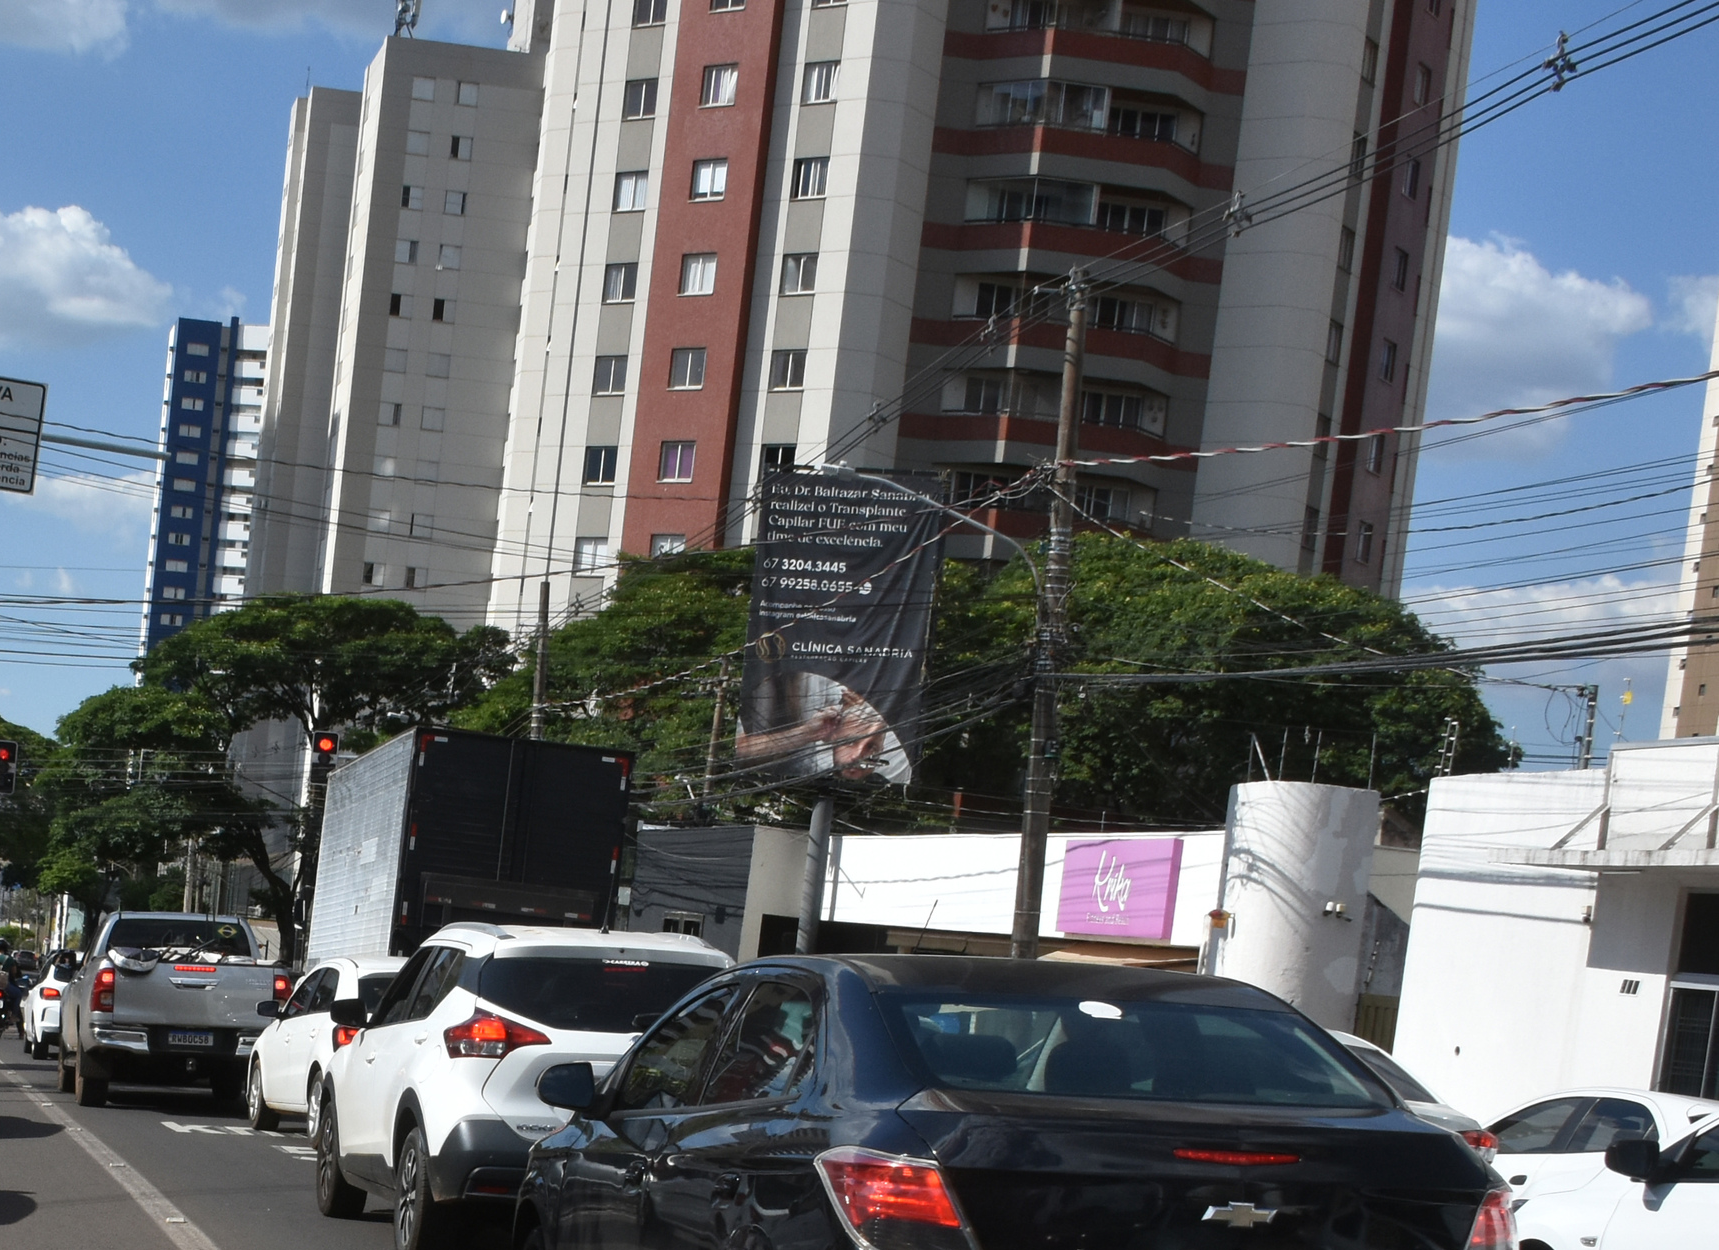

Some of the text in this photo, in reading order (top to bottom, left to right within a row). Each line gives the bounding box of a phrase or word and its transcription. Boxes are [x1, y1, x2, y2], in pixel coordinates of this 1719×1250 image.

[794, 486, 811, 496] Dr.
[814, 486, 868, 500] Baltazar
[770, 501, 815, 512] realizei
[829, 502, 907, 518] Transplante
[768, 515, 816, 530] Capilar
[879, 523, 908, 533] meu
[763, 557, 847, 573] 67 3204.3445
[761, 576, 853, 592] 67 99258.0655
[791, 640, 843, 654] CLÍNICA
